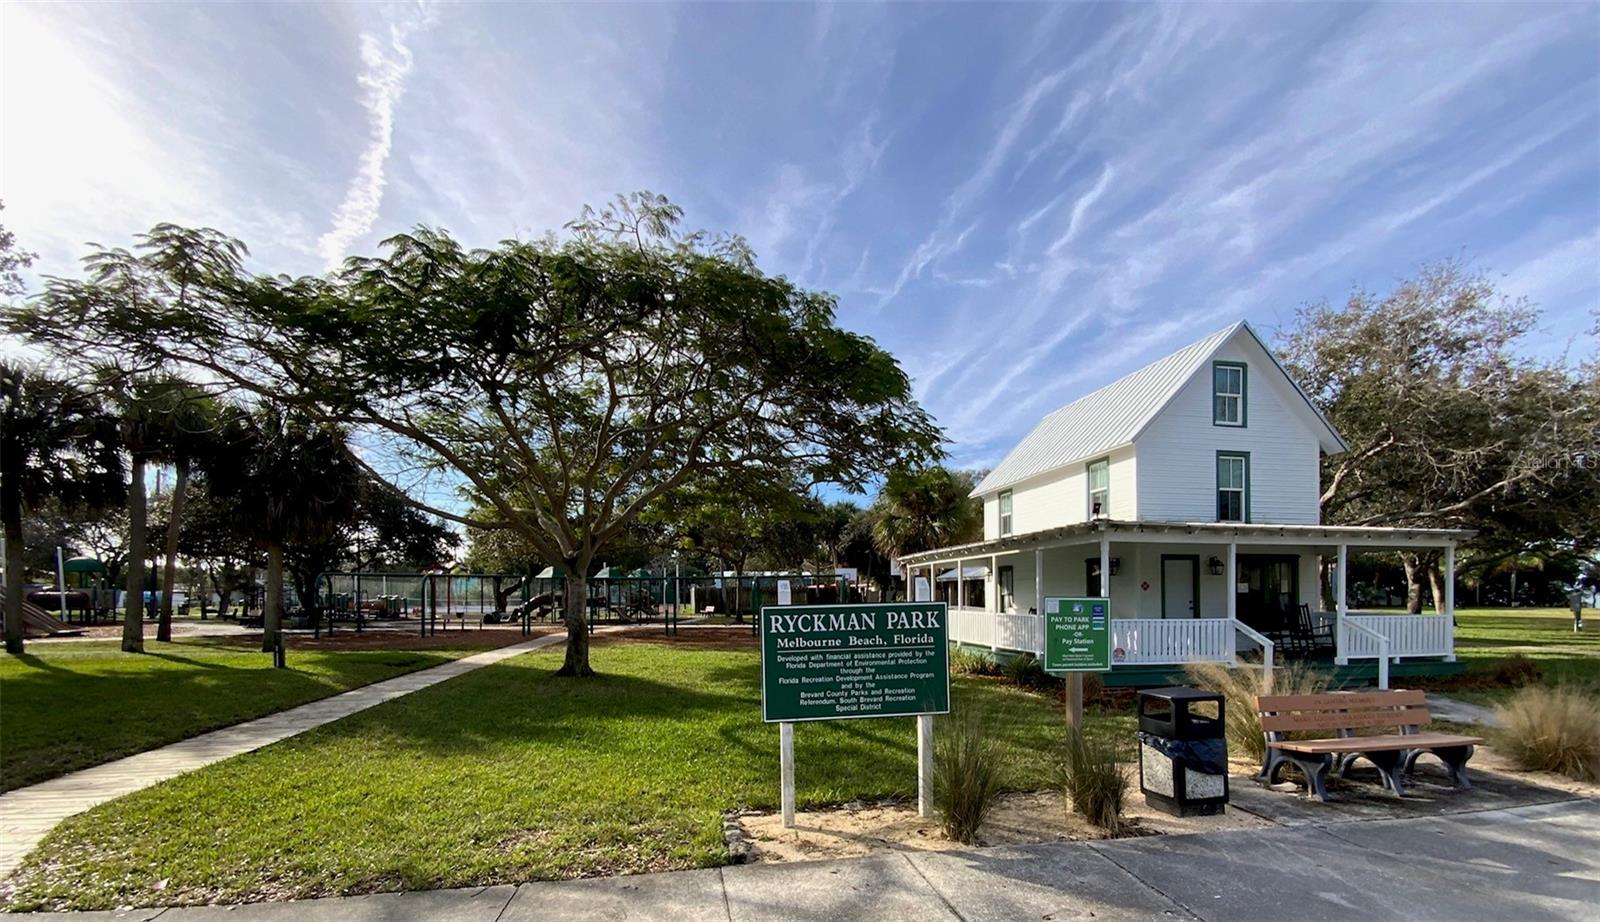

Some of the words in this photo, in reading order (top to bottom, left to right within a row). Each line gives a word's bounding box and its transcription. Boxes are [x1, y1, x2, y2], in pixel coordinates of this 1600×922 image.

[769, 612, 876, 634] RYCKMAN
[886, 611, 941, 630] PARK
[777, 637, 842, 649] Melbourne
[849, 635, 887, 647] Beach,
[894, 633, 934, 645] Florida
[1062, 638, 1073, 646] Pay
[777, 654, 808, 663] Developed
[810, 653, 823, 661] with
[826, 653, 851, 661] financial
[888, 650, 913, 659] provided
[915, 650, 923, 658] by
[925, 649, 935, 657] the
[809, 661, 844, 669] Department
[854, 659, 897, 667] Environmental
[840, 667, 863, 675] through
[778, 677, 799, 685] Florida
[801, 676, 834, 684] Recreation
[835, 674, 873, 682] Development
[909, 671, 935, 679] Program
[854, 682, 863, 690] by
[800, 691, 825, 699] Brevard
[826, 690, 848, 698] County
[835, 704, 859, 712] Special
[860, 703, 882, 711] District
